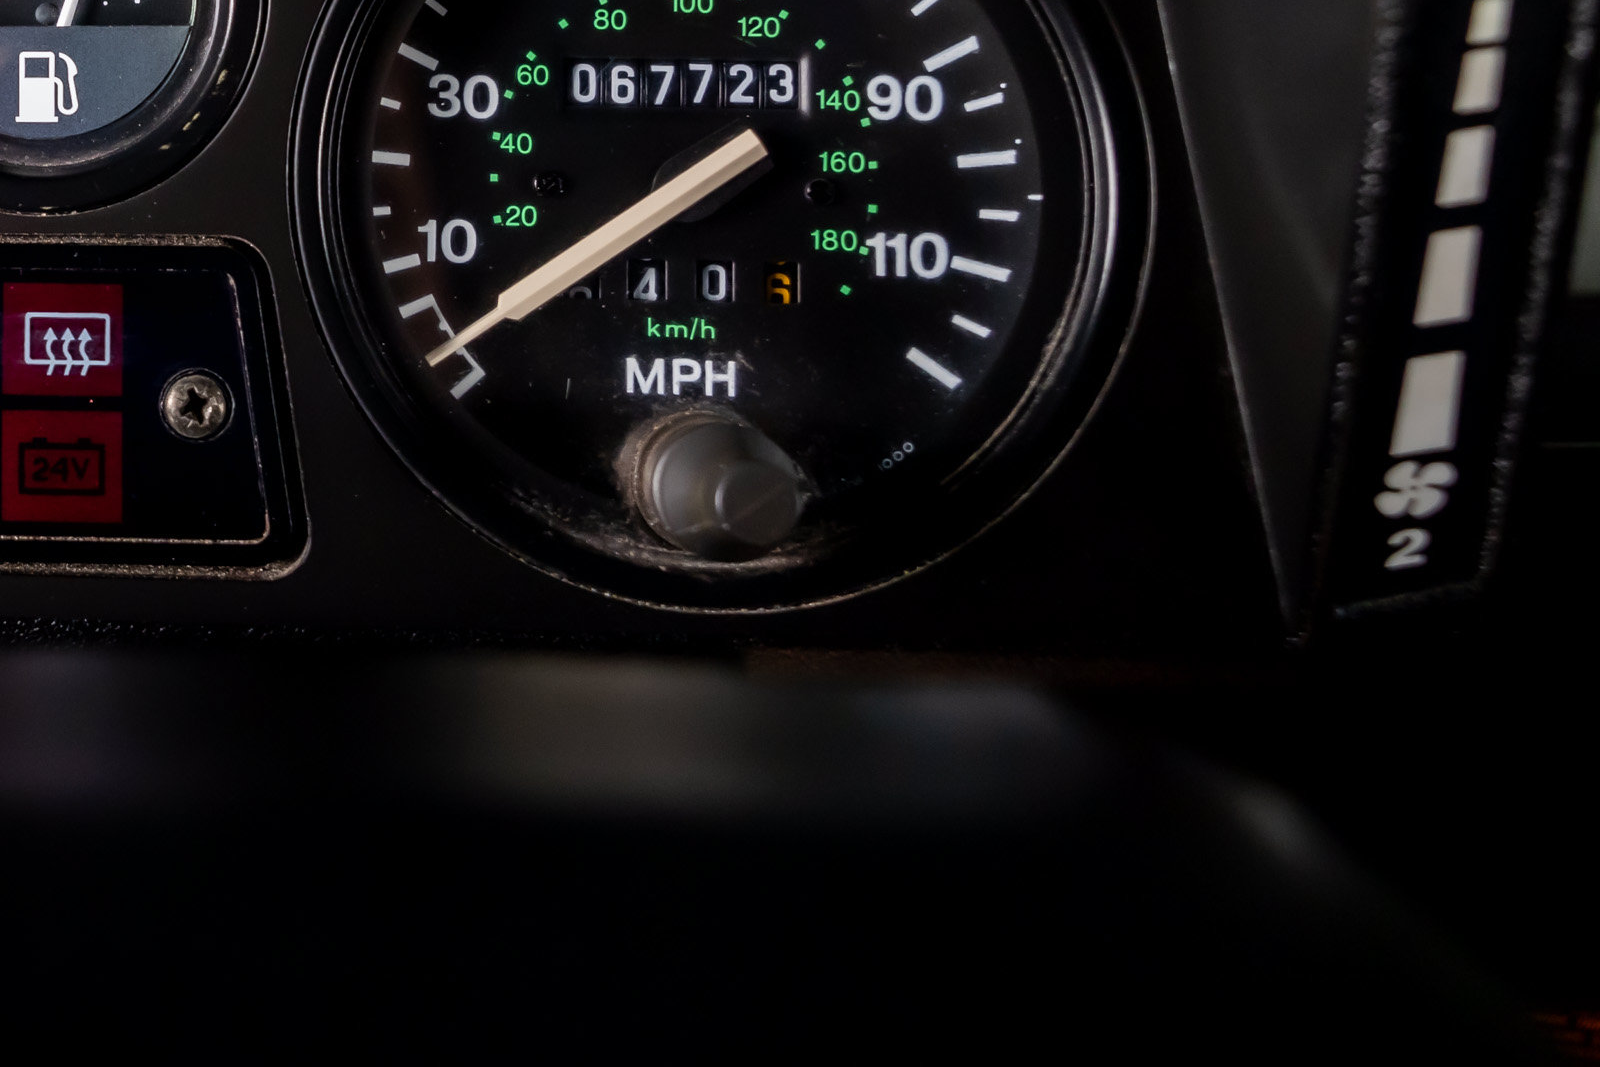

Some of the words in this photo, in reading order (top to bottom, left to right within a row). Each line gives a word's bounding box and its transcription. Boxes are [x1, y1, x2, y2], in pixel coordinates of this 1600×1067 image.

[593, 8, 628, 31] 80
[737, 16, 781, 39] 120
[516, 63, 549, 87] 60
[571, 62, 795, 106] 067723
[426, 73, 500, 121] 30
[815, 89, 860, 112] 140
[866, 74, 943, 123] 90
[500, 133, 532, 155] 40
[819, 151, 865, 175] 160
[505, 205, 537, 228] 20
[417, 218, 477, 264] 10
[811, 229, 858, 253] 180
[865, 232, 949, 279] 110
[646, 318, 717, 340] km/h
[625, 356, 736, 397] MPH
[32, 457, 91, 482] 24V
[1382, 527, 1433, 571] 2
